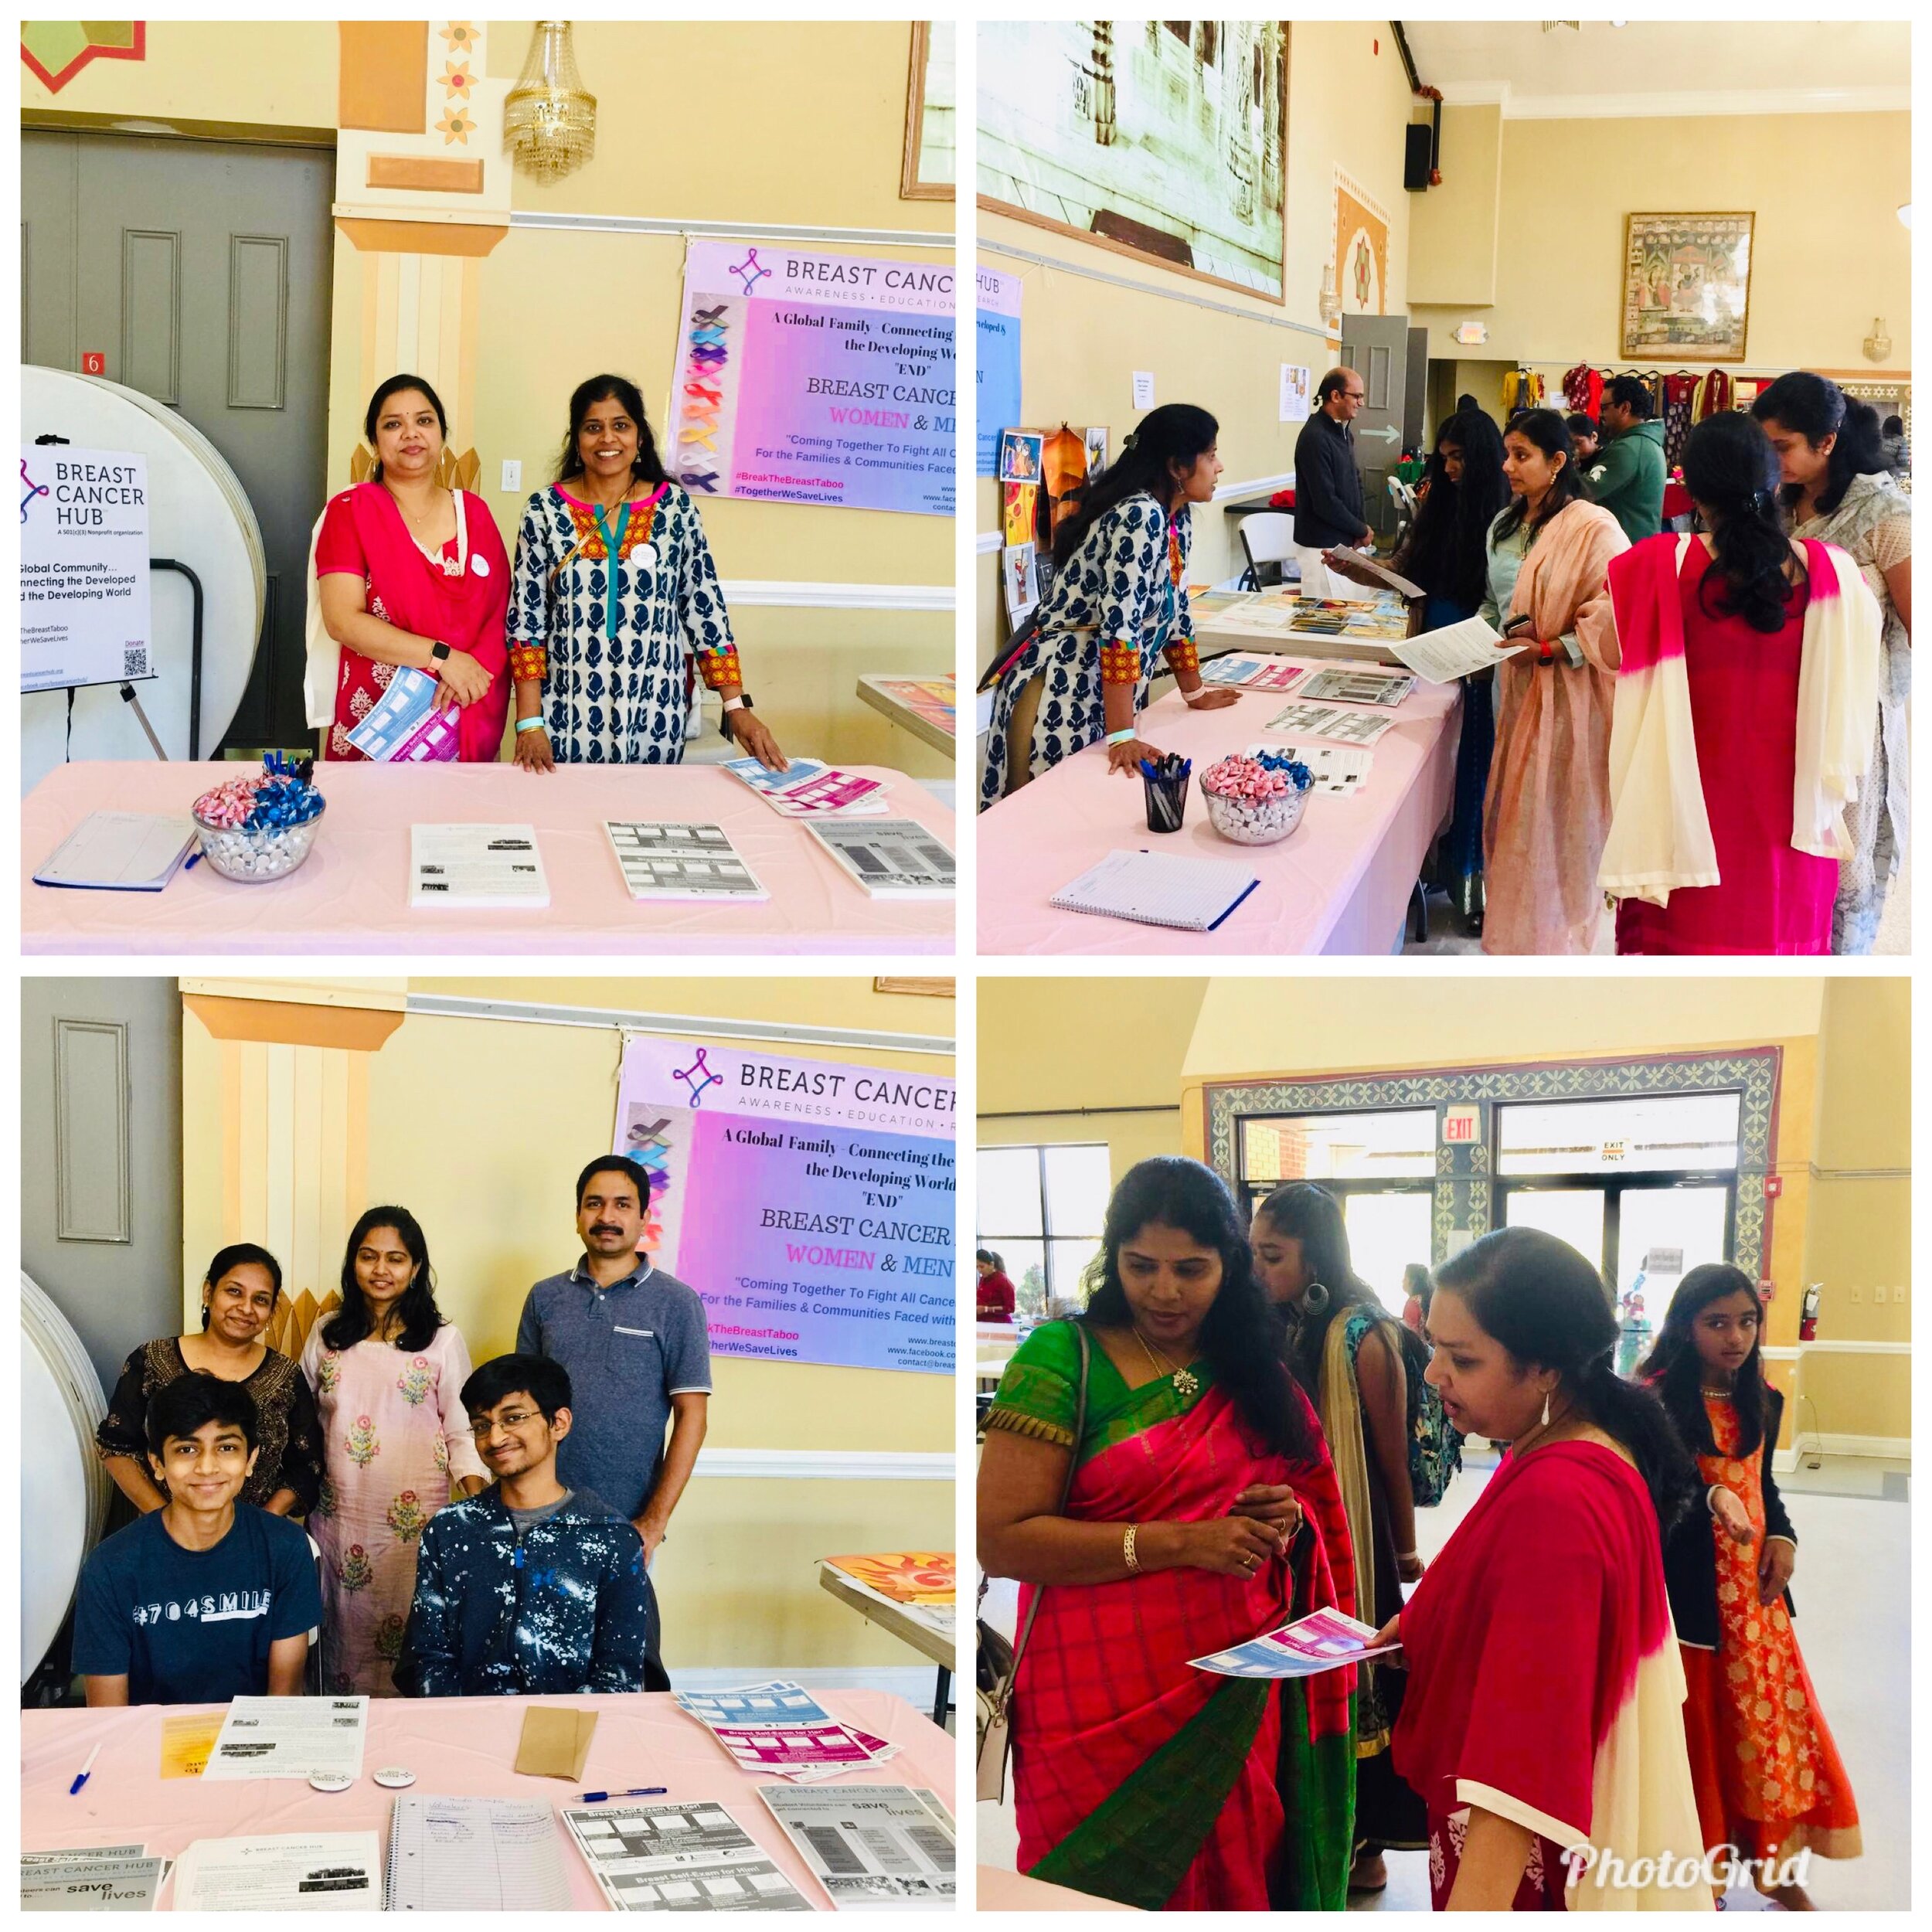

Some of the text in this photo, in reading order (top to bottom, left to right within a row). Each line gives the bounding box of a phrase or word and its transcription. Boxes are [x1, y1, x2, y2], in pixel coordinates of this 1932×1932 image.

[786, 260, 954, 293] BREAST CANC
[785, 285, 956, 310] AWARENESS EDUCATION
[772, 311, 781, 325] A
[784, 312, 824, 328] Global
[829, 316, 871, 335] Family
[881, 321, 953, 344] Connecting
[845, 338, 866, 352] the
[868, 340, 938, 362] Developing
[88, 355, 99, 372] 6
[895, 362, 931, 377] "END"
[807, 378, 889, 400] BREAST
[829, 406, 910, 429] WOMEN
[913, 414, 929, 430] &
[786, 434, 833, 450] "Coming
[836, 438, 883, 454] Together
[886, 443, 900, 453] To
[903, 444, 930, 457] Fight
[932, 447, 947, 457] All
[756, 447, 773, 460] For
[776, 448, 793, 461] the
[796, 451, 841, 465] Families
[844, 454, 857, 465] &
[857, 455, 924, 472] Communities
[56, 462, 136, 484] BREAST
[735, 471, 844, 489] #BreakTheBreastTaboo
[56, 485, 145, 505] CANCER
[735, 485, 843, 503] #TogetherWeSaveLives
[56, 507, 103, 526] HUB
[67, 576, 83, 586] the
[86, 574, 136, 587] Developed
[29, 591, 45, 600] the
[48, 589, 103, 600] Developing
[105, 587, 131, 597] World
[124, 639, 145, 648] Donate
[740, 1063, 845, 1097] BREAST
[738, 1095, 832, 1116] AWARENESS
[848, 1109, 934, 1128] EDUCATION
[1447, 1117, 1474, 1140] EXIT
[723, 1128, 732, 1142] A
[736, 1129, 783, 1148] Global
[788, 1134, 837, 1157] Family
[848, 1141, 929, 1168] Connecting
[931, 1152, 955, 1168] the
[1604, 1141, 1624, 1149] EXIT
[806, 1162, 829, 1178] the
[832, 1164, 912, 1190] Developing
[862, 1190, 903, 1208] "END"
[760, 1208, 951, 1246] BREAST CANCER
[785, 1243, 956, 1277] WOMEN & MEN
[735, 1276, 788, 1294] "Coming
[792, 1281, 845, 1298] Together
[850, 1287, 864, 1299] To
[867, 1289, 897, 1304] Fight
[900, 1292, 917, 1304] All
[699, 1292, 956, 1325] For the Families & Communities Faced with
[852, 1801, 889, 1810] save
[886, 1808, 924, 1816] lives
[64, 1864, 120, 1873] CANCER
[125, 1861, 153, 1869] HUB
[635, 1874, 670, 1884] Breast
[671, 1870, 719, 1880] Self-Exam
[66, 1883, 113, 1893] save
[101, 1890, 147, 1900] lives
